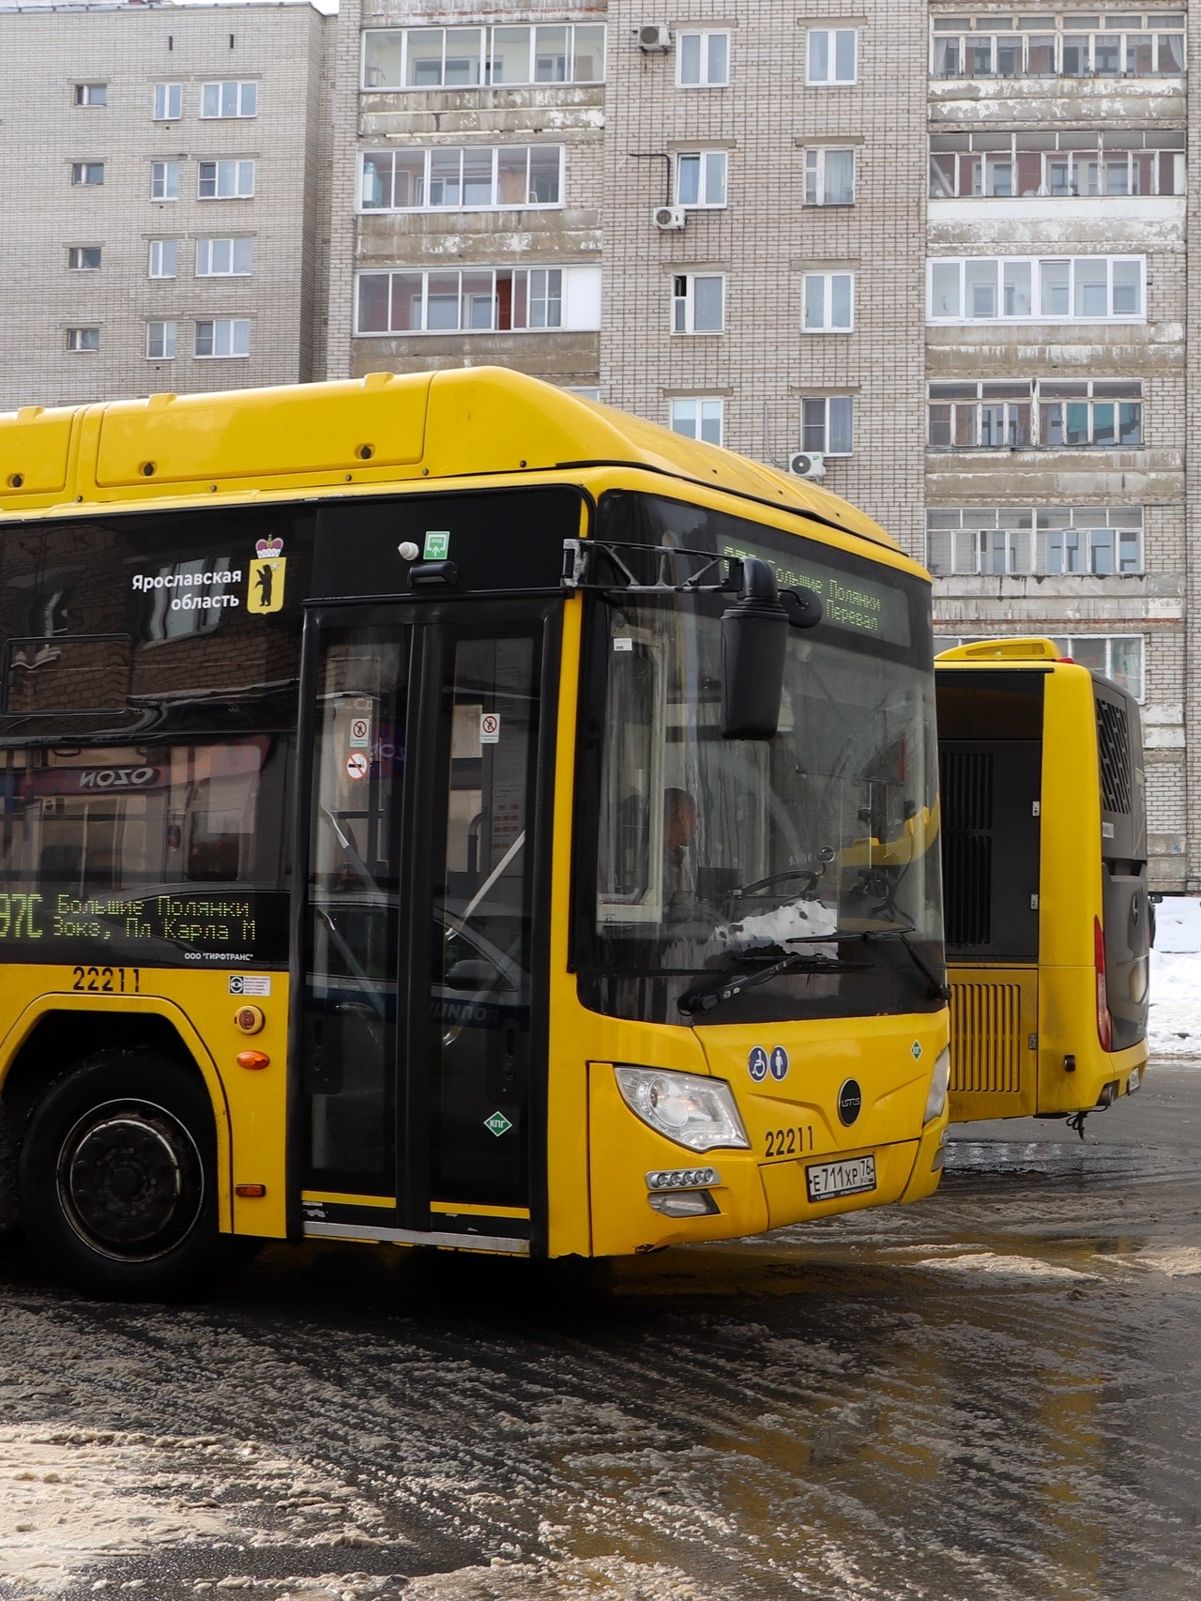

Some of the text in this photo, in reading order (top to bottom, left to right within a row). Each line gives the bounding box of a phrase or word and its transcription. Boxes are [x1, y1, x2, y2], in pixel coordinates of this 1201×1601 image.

[132, 570, 242, 592] Ярославская
[768, 559, 822, 594] ольшие
[829, 579, 881, 612] Полянки
[171, 593, 240, 610] область
[826, 598, 878, 631] Перевал
[57, 894, 249, 917] Большие Полянки
[125, 917, 151, 938] Пл
[164, 918, 229, 941] Карла
[242, 919, 256, 940] М
[184, 952, 202, 960] ООО
[73, 966, 140, 993] 22211
[490, 1119, 506, 1128] КПГ
[765, 1126, 813, 1157] 22211
[860, 1160, 872, 1177] 76
